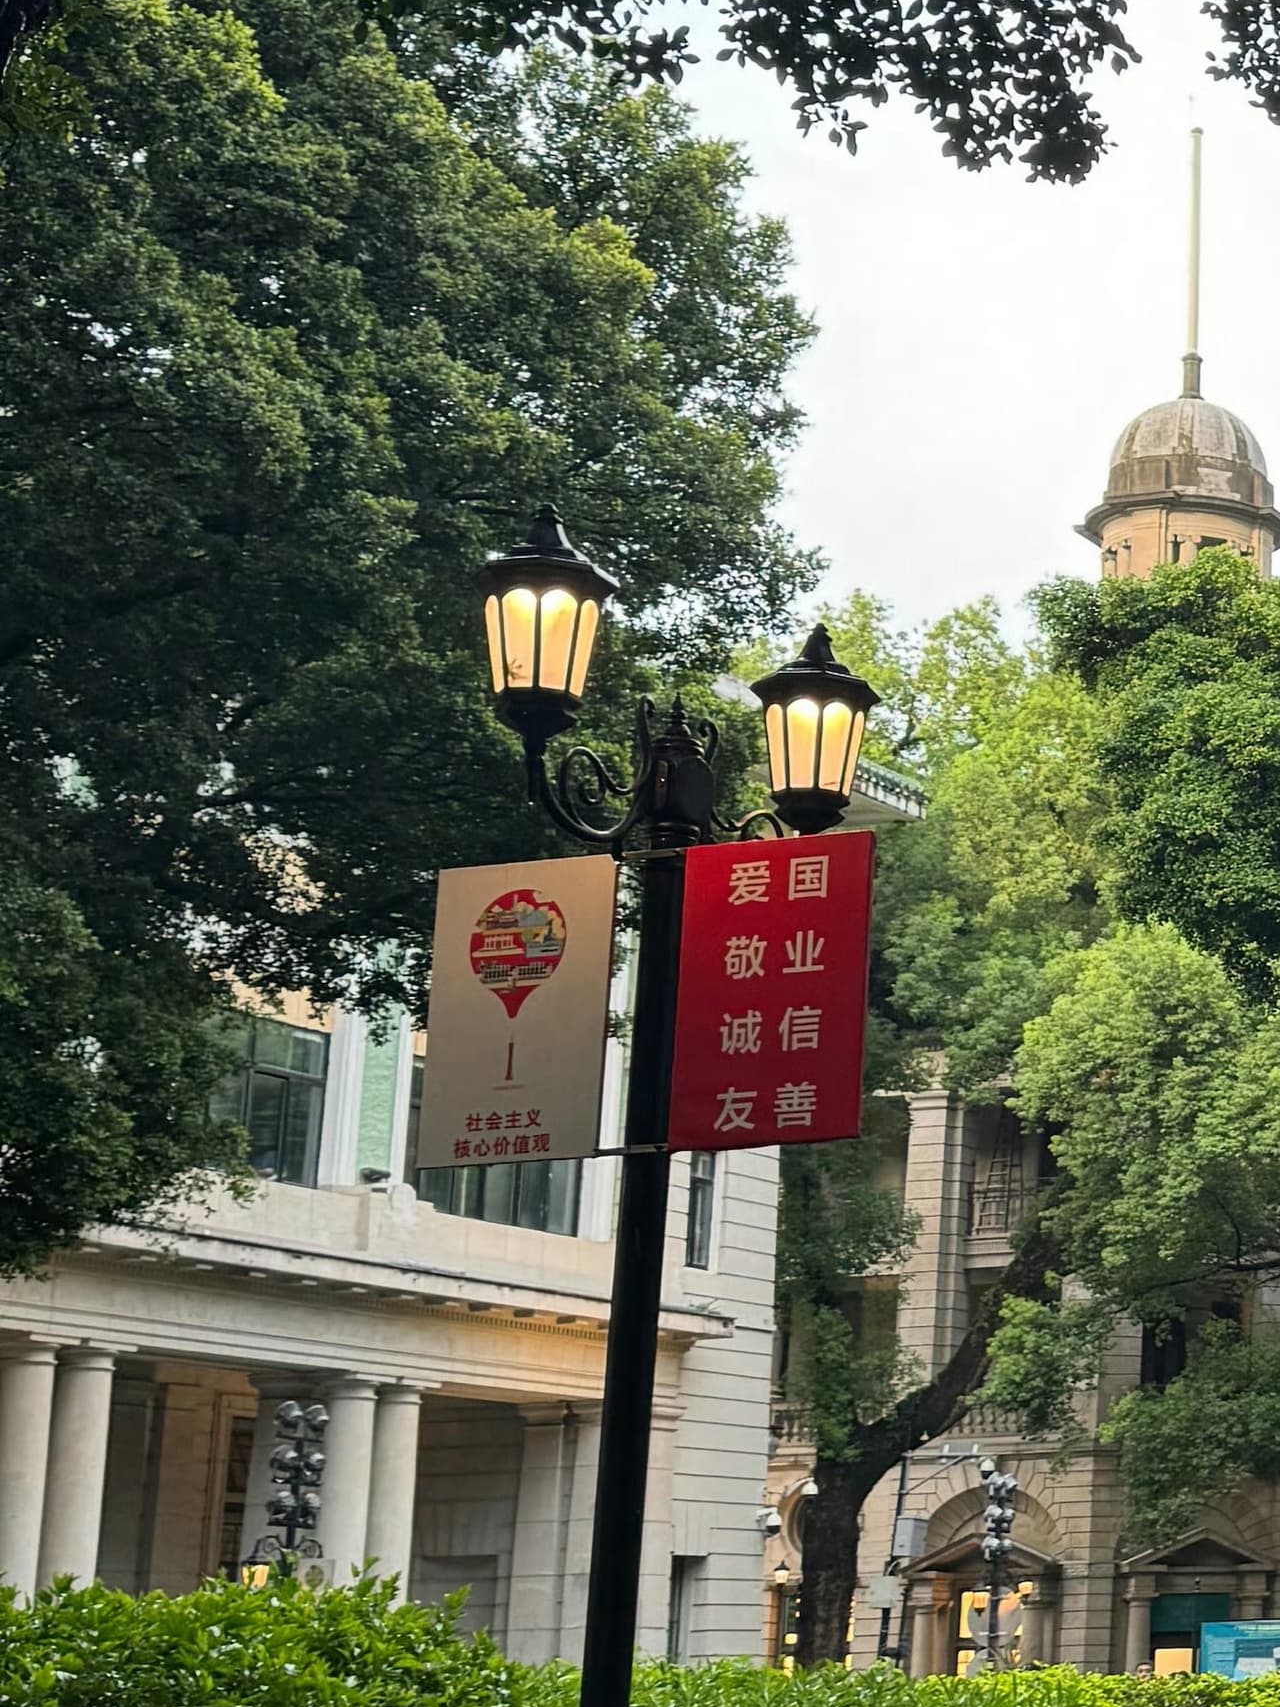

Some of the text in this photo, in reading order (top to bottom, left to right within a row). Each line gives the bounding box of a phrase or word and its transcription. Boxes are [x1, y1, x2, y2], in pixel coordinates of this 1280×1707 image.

[727, 854, 830, 906] 爱国
[723, 930, 825, 981] 敬业
[719, 1006, 823, 1056] 诚信
[465, 1109, 542, 1132] 社会主义
[713, 1082, 818, 1133] 友善
[454, 1133, 550, 1159] 核心价值观
